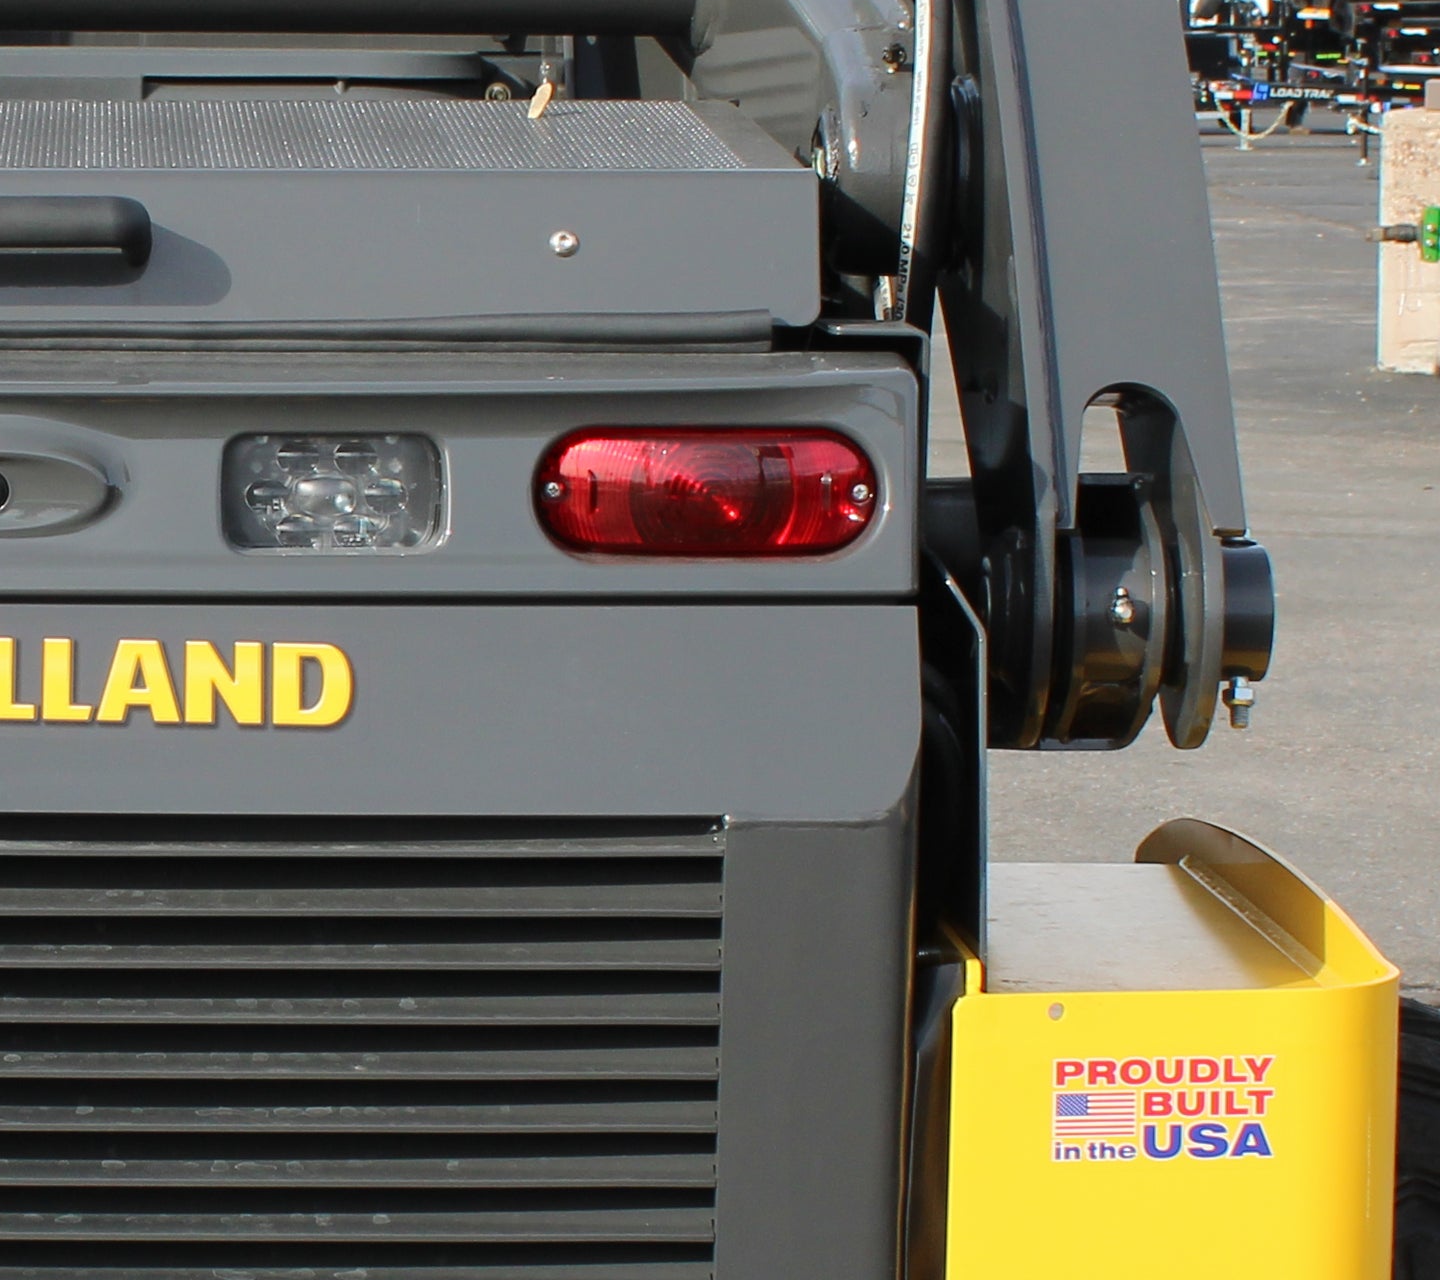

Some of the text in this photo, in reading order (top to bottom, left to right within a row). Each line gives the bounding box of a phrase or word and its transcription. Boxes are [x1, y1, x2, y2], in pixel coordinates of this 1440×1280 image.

[1270, 87, 1304, 98] LOAD
[1055, 1056, 1273, 1086] PROUDLY
[1143, 1089, 1274, 1117] BUILT
[1055, 1122, 1273, 1160] in the USA
